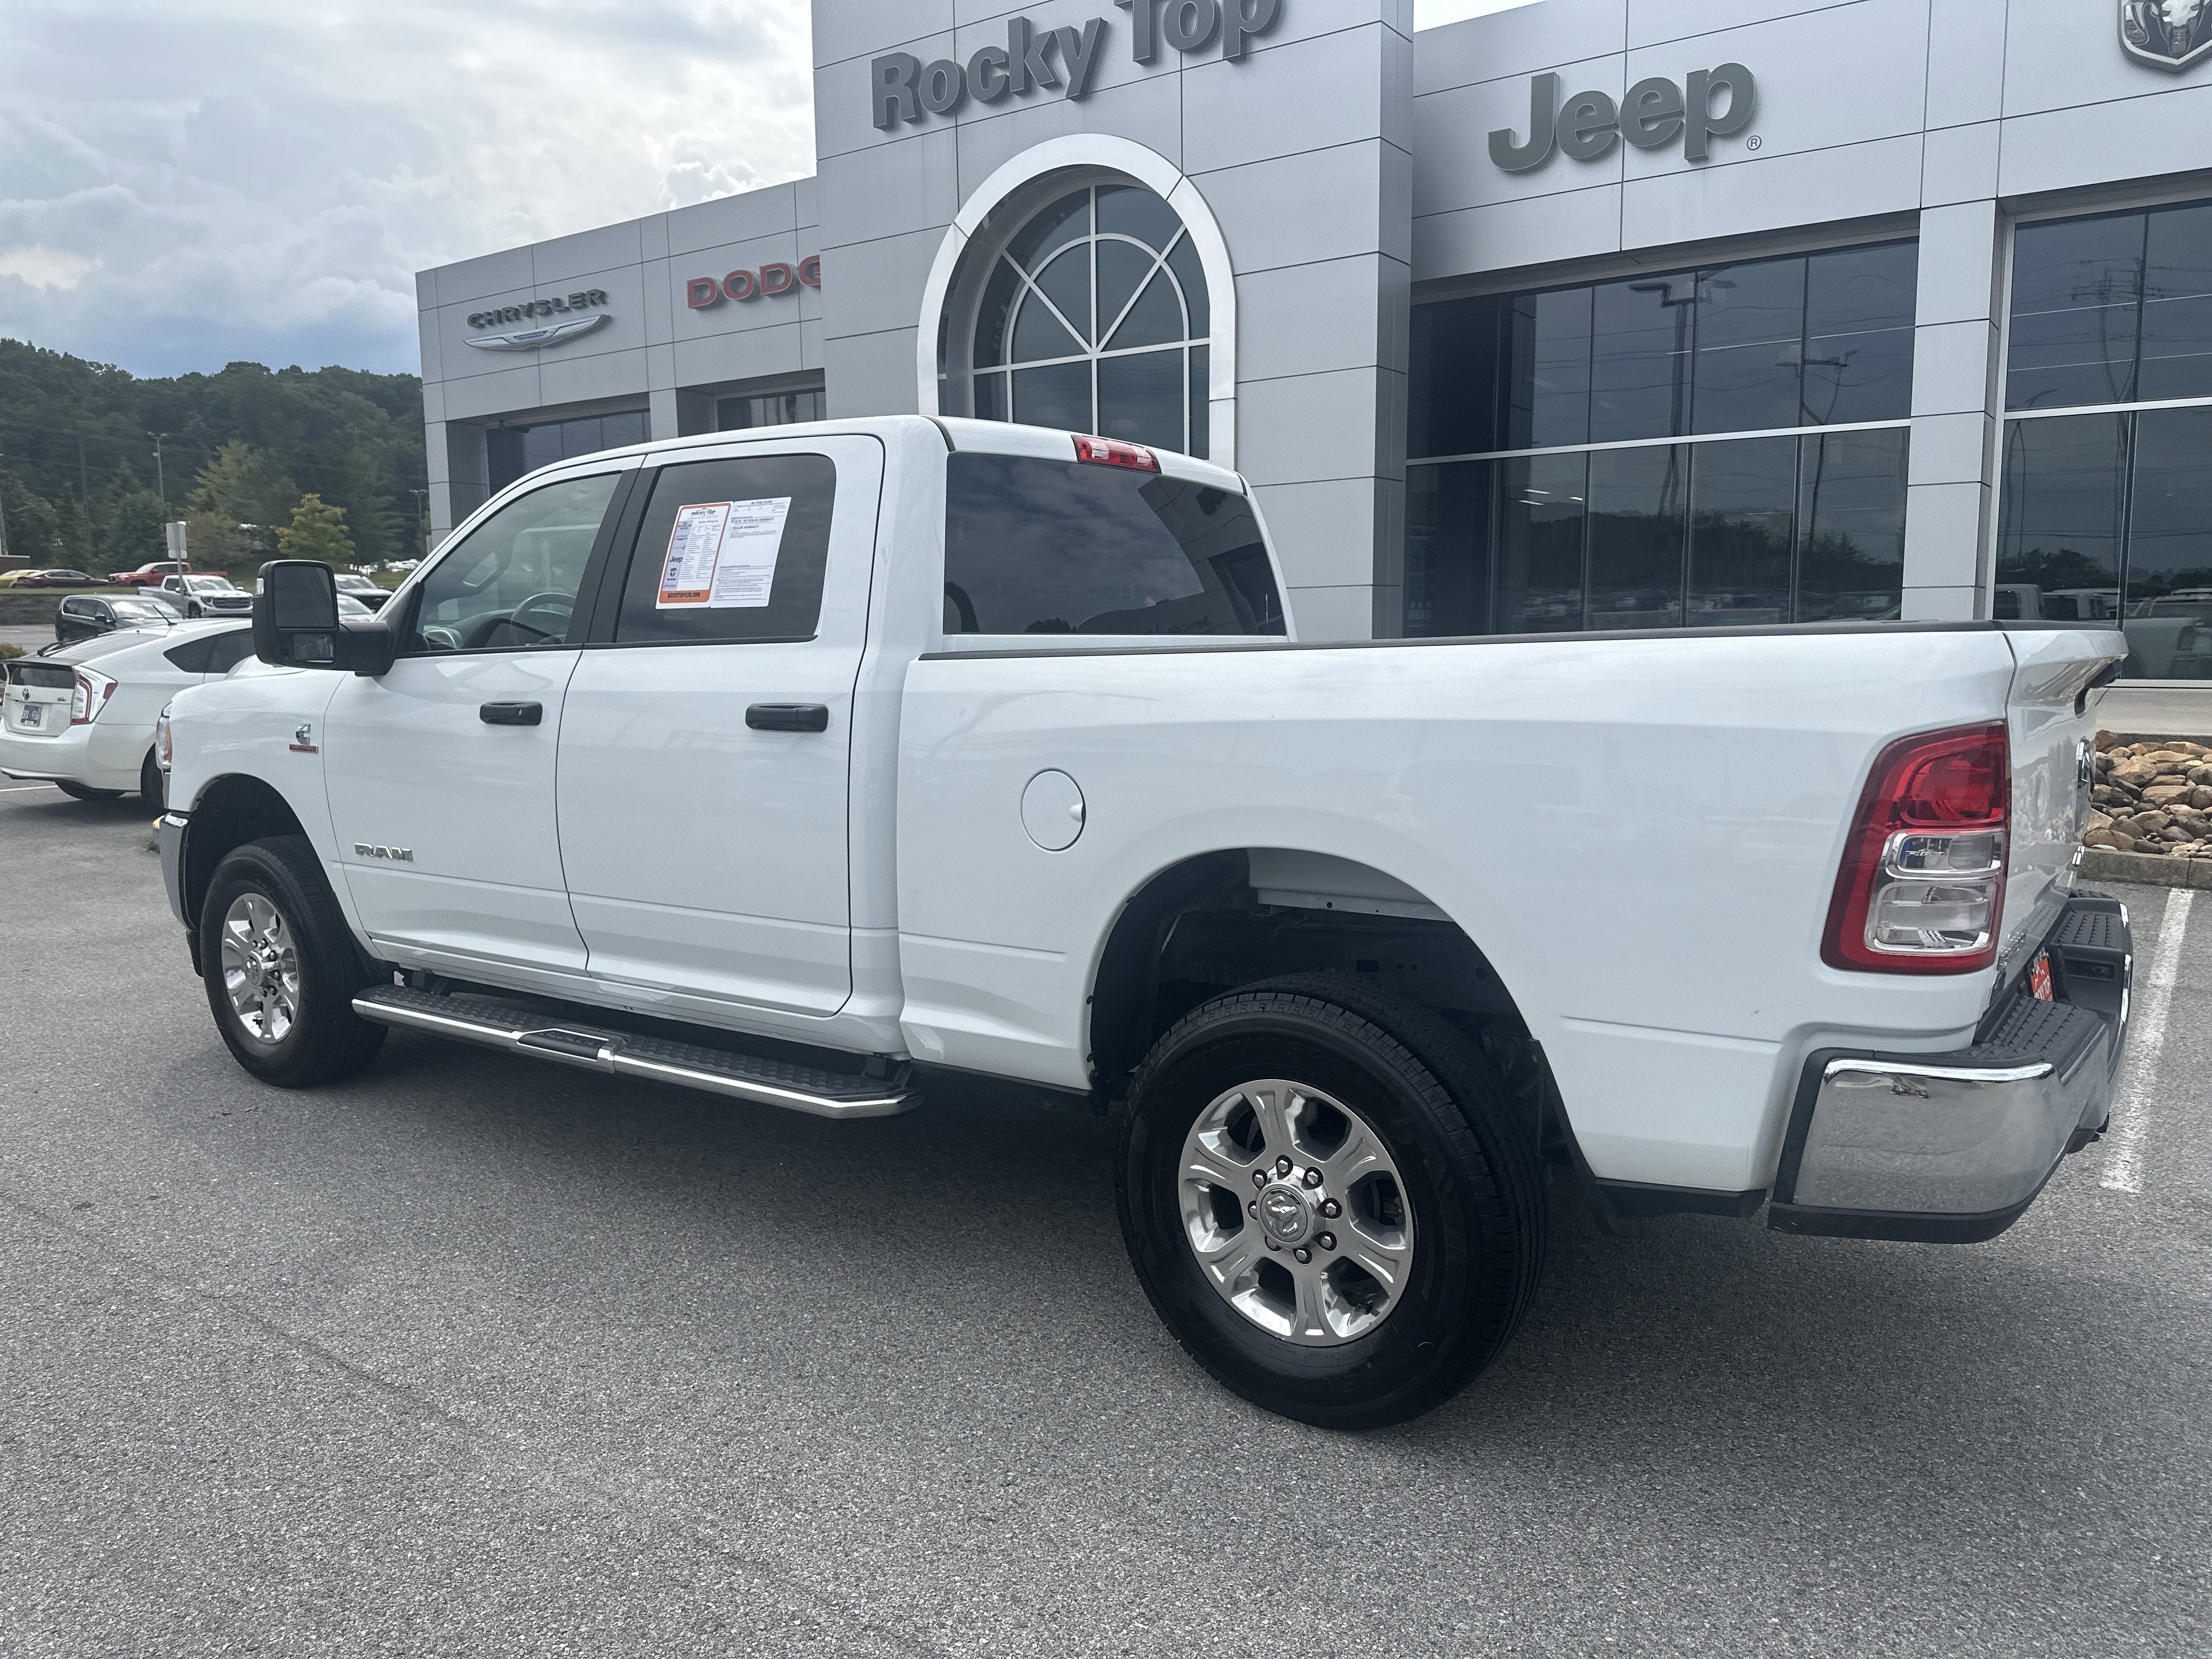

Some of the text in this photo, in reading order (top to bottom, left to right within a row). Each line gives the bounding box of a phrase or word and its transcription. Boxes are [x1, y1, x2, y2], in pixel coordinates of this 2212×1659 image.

[871, 0, 1280, 129] Rocky Top
[1488, 62, 1757, 172] Jeep
[467, 289, 610, 329] CHRYSLER
[354, 842, 413, 862] RAM
